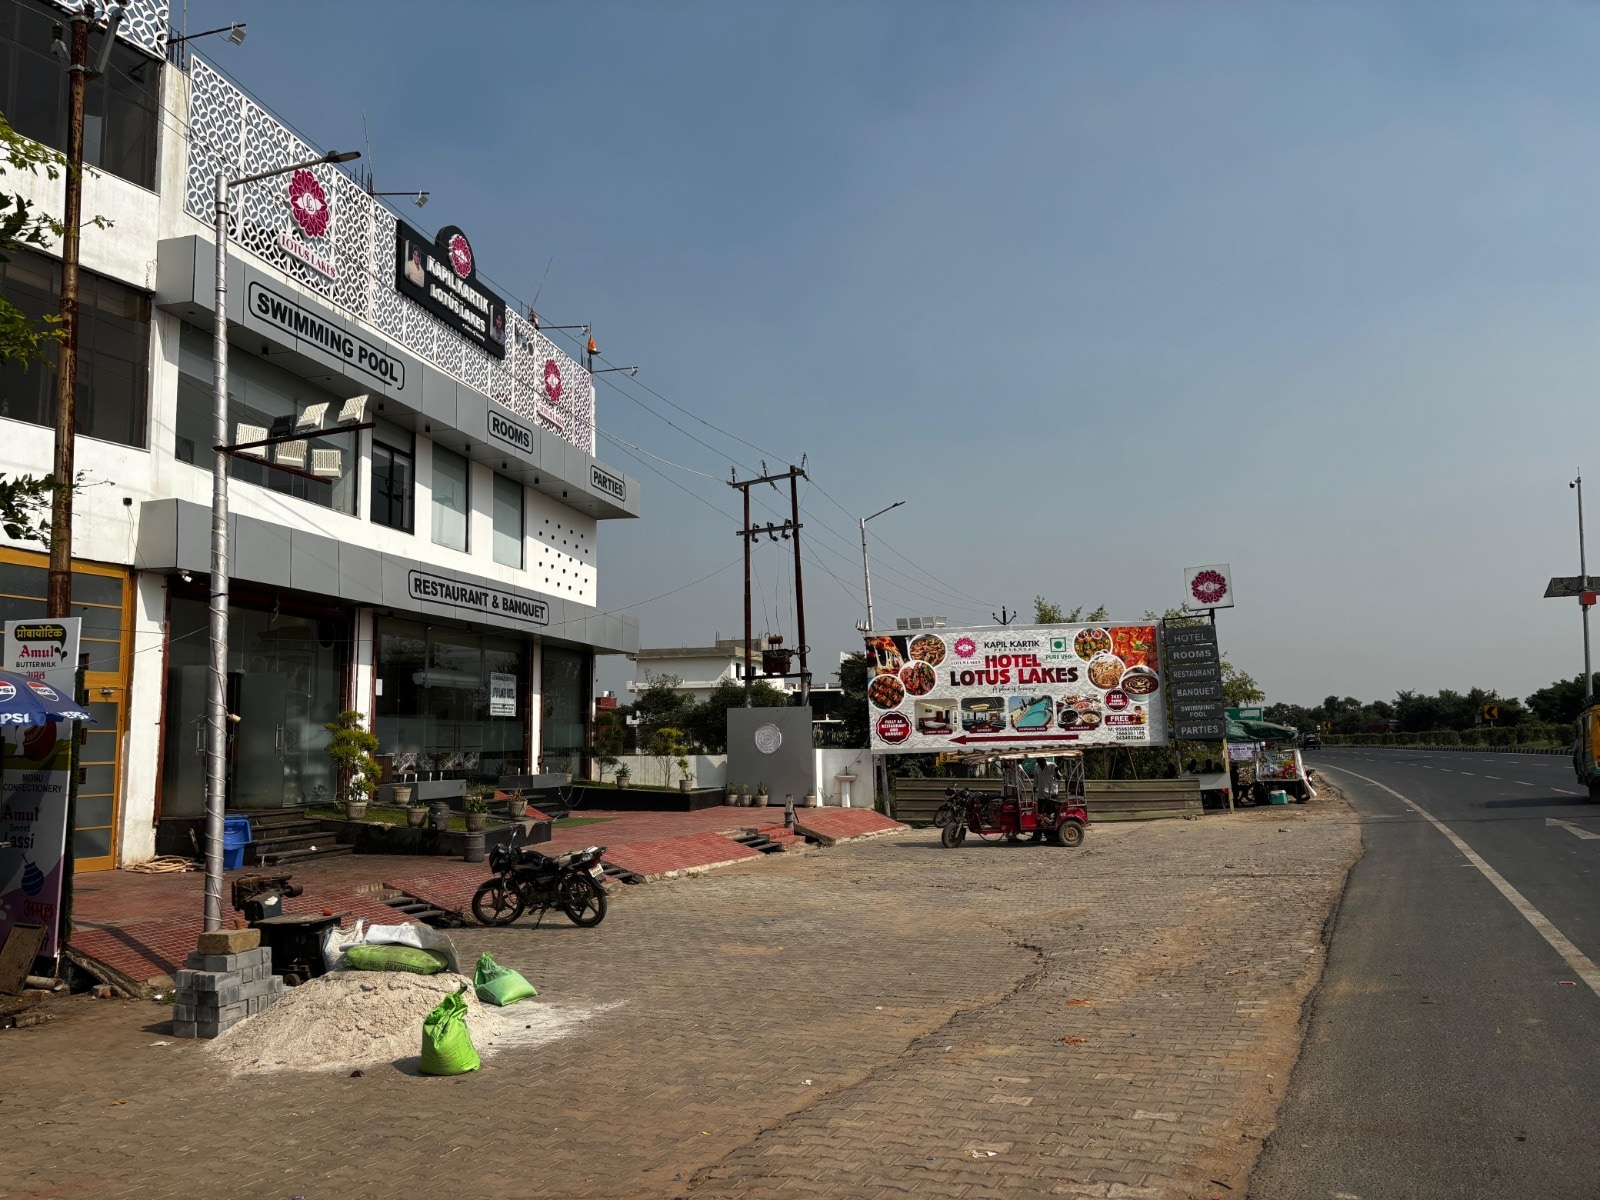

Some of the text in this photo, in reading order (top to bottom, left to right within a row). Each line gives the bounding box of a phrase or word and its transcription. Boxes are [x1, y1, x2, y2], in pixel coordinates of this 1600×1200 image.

[282, 235, 336, 278] LOTUS LAKES
[426, 255, 456, 290] KAPIL
[456, 278, 489, 314] KARTIK
[430, 284, 459, 314] LOTUS
[458, 305, 486, 332] LAKES
[257, 293, 398, 382] SWIMMING POOL
[493, 417, 530, 448] ROOMS
[594, 470, 624, 497] PARTIES
[414, 578, 545, 619] RESTAURANT & BANQUET
[1010, 640, 1040, 648] KARTIK
[1174, 634, 1207, 642] HOTEL
[19, 644, 54, 658] Amul
[1173, 650, 1211, 660] ROOMS
[985, 654, 1041, 668] HOTEL
[950, 667, 1079, 686] LOTUS LAKES
[1173, 668, 1216, 678] RESTAURANT
[1177, 687, 1215, 697] BANQUET
[1181, 726, 1218, 735] PARTIES
[22, 774, 44, 782] MONU
[3, 783, 63, 793] CONFECTIONERY
[2, 805, 39, 822] Amul
[9, 824, 30, 832] Sweet
